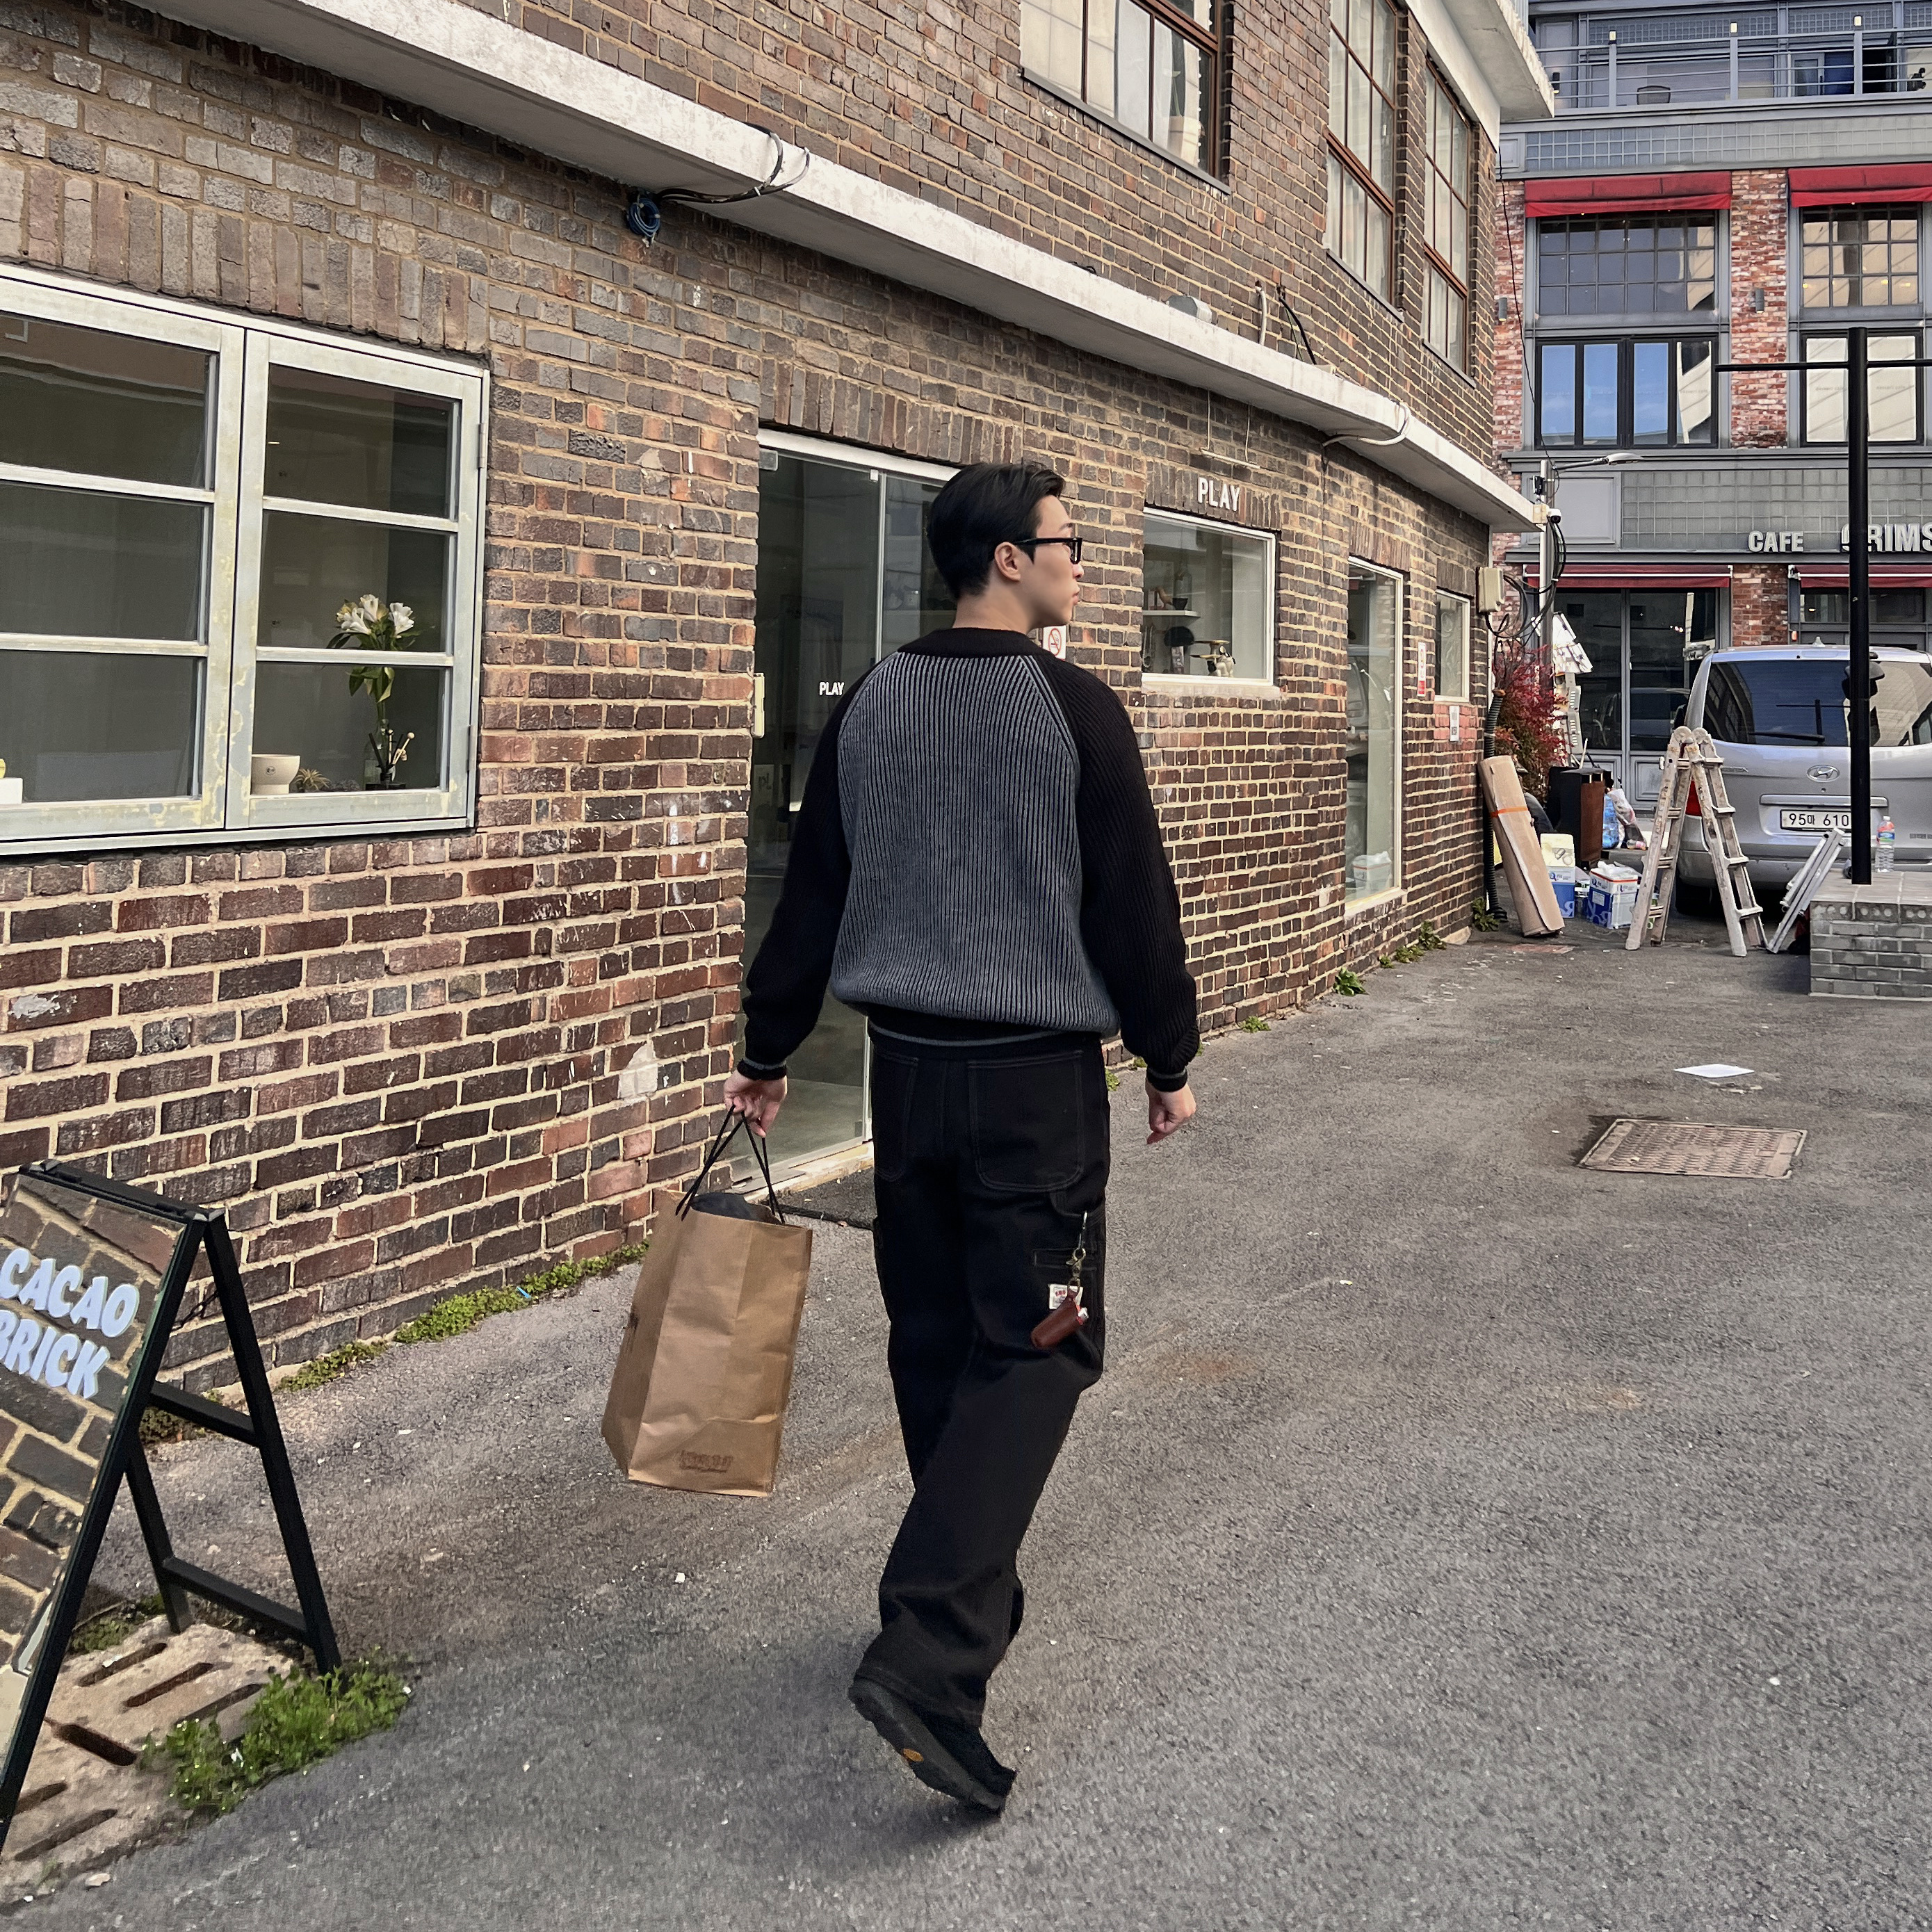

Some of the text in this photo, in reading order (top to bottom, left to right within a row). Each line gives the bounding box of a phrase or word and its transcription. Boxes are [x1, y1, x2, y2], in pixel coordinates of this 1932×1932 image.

[1198, 477, 1240, 512] PLAY
[1748, 530, 1804, 552] CAFE
[819, 681, 845, 696] PLAY
[1789, 813, 1850, 827] 95마 610
[0, 1248, 140, 1338] CACAO
